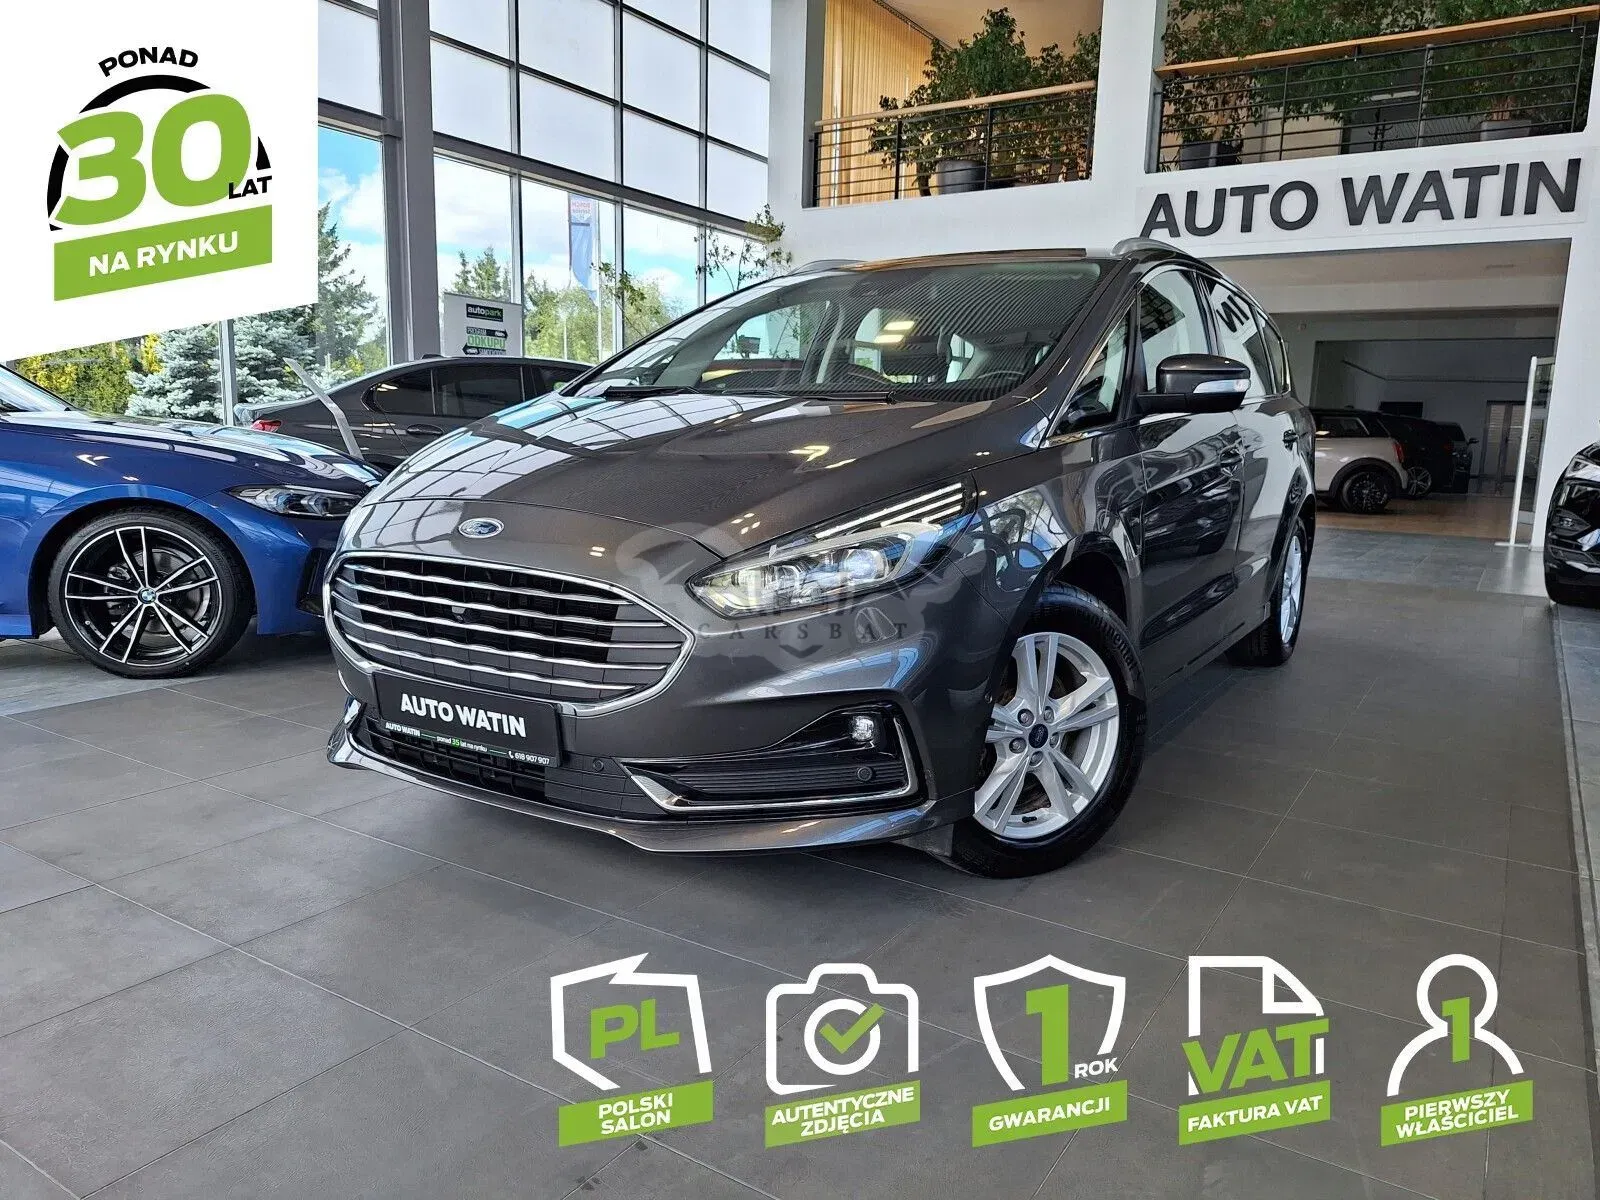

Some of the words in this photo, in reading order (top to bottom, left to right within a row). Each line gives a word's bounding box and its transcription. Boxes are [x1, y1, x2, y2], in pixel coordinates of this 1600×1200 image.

[1139, 180, 1319, 239] AUTO
[1341, 157, 1582, 226] WATIN
[467, 306, 502, 317] autopark
[467, 335, 506, 349] ODKUPU
[400, 693, 454, 722] AUTO
[454, 704, 527, 738] WATIN
[385, 722, 401, 732] AUTO
[401, 726, 420, 737] WATIN
[452, 738, 460, 746] 35
[525, 754, 537, 762] 907
[537, 756, 550, 765] 907
